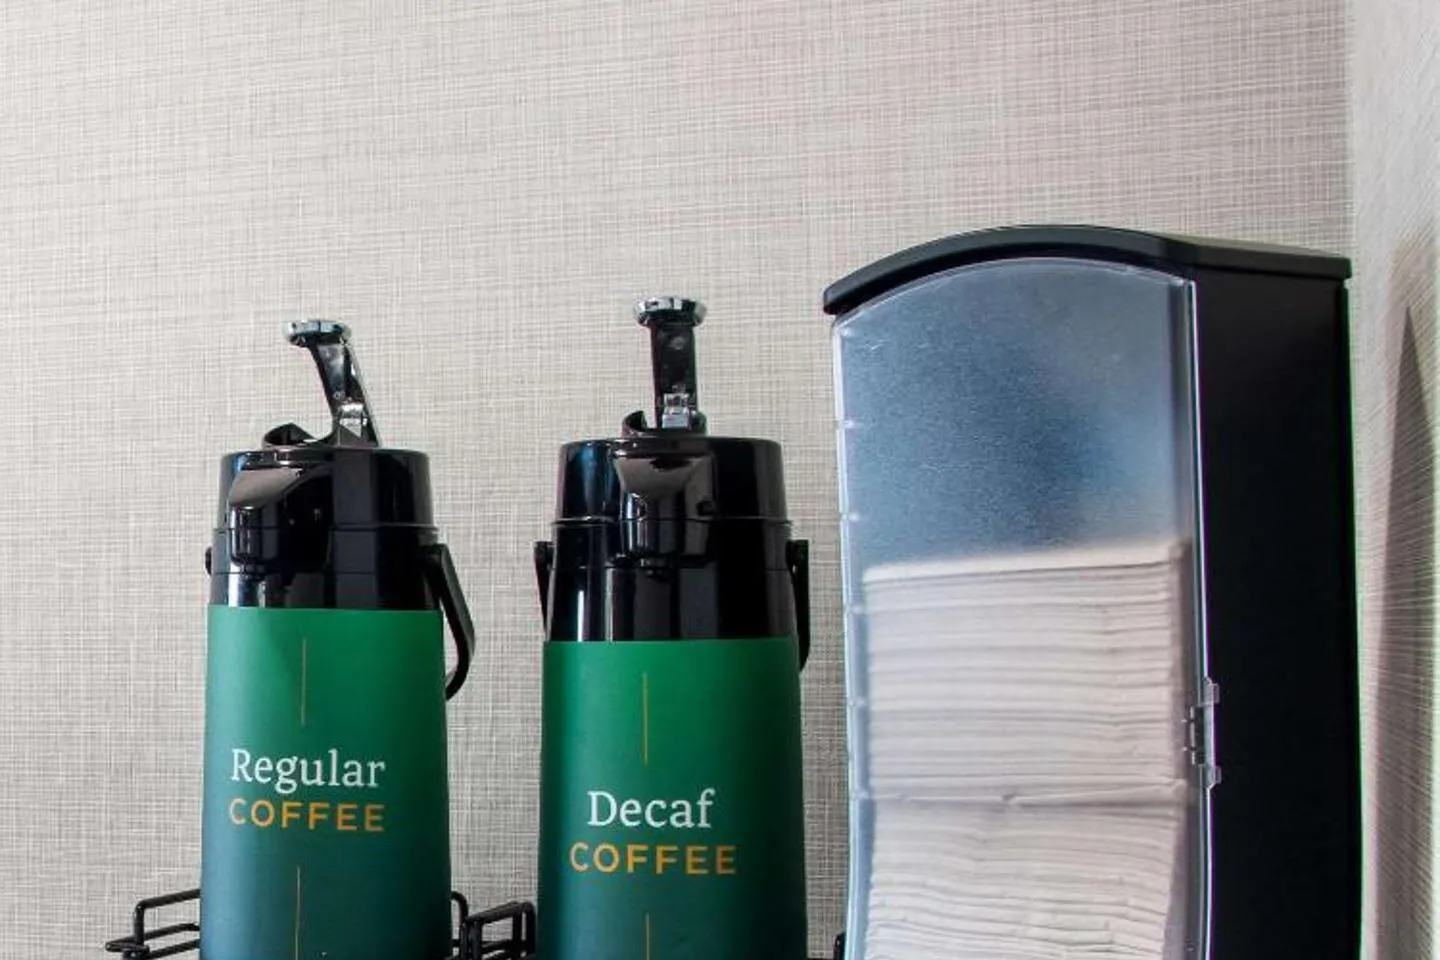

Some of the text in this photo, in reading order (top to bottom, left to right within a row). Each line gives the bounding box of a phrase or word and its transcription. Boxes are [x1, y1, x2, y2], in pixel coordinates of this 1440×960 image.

[230, 748, 386, 794] Regular
[228, 797, 386, 832] COFFEE
[586, 787, 717, 829] Decaf
[569, 841, 738, 875] COFFEE
